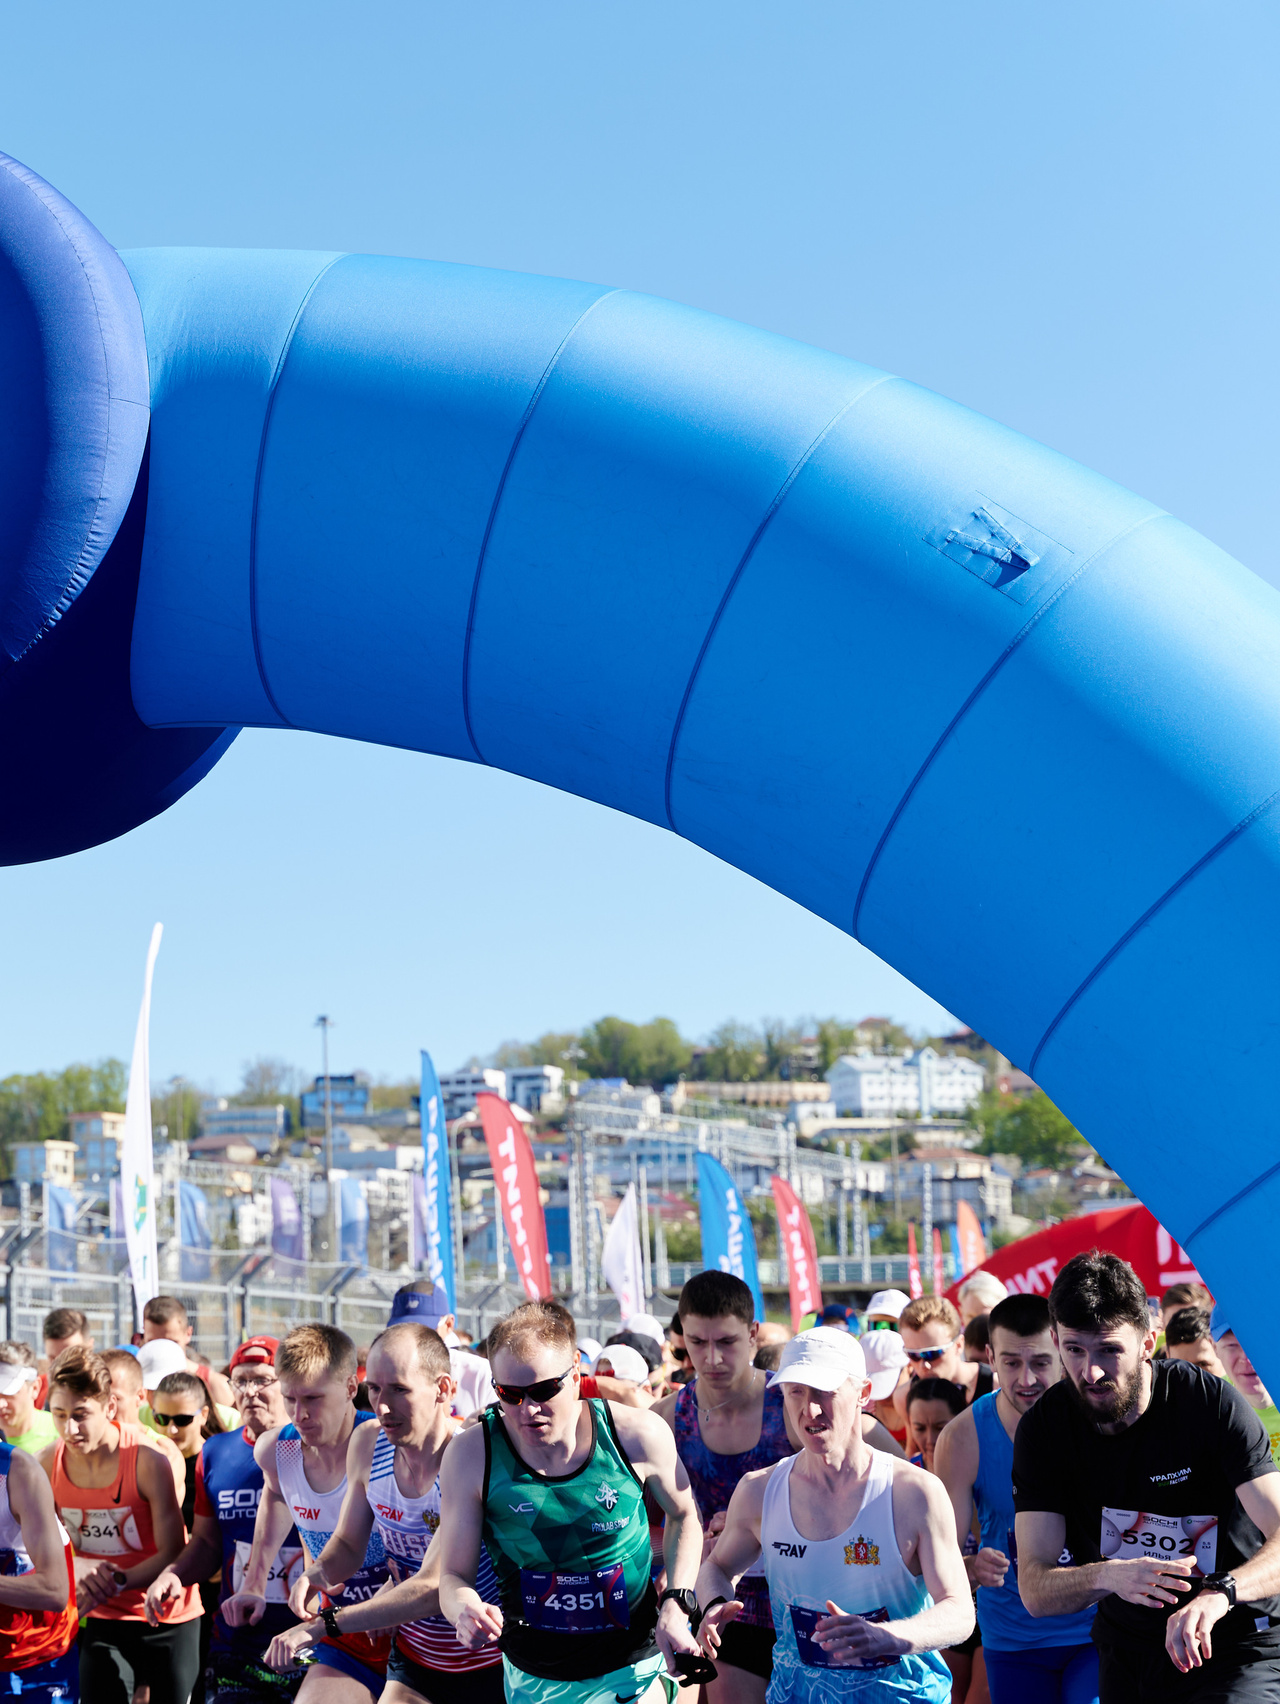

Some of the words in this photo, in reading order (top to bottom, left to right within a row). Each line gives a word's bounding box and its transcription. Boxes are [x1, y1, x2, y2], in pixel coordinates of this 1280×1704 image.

[219, 1508, 257, 1520] AUTO
[1142, 1515, 1178, 1526] SOCHI
[81, 1525, 121, 1538] 5341
[1122, 1529, 1195, 1554] 5302
[1144, 1550, 1171, 1561] ИЛЬЯ
[544, 1591, 605, 1611] 4351
